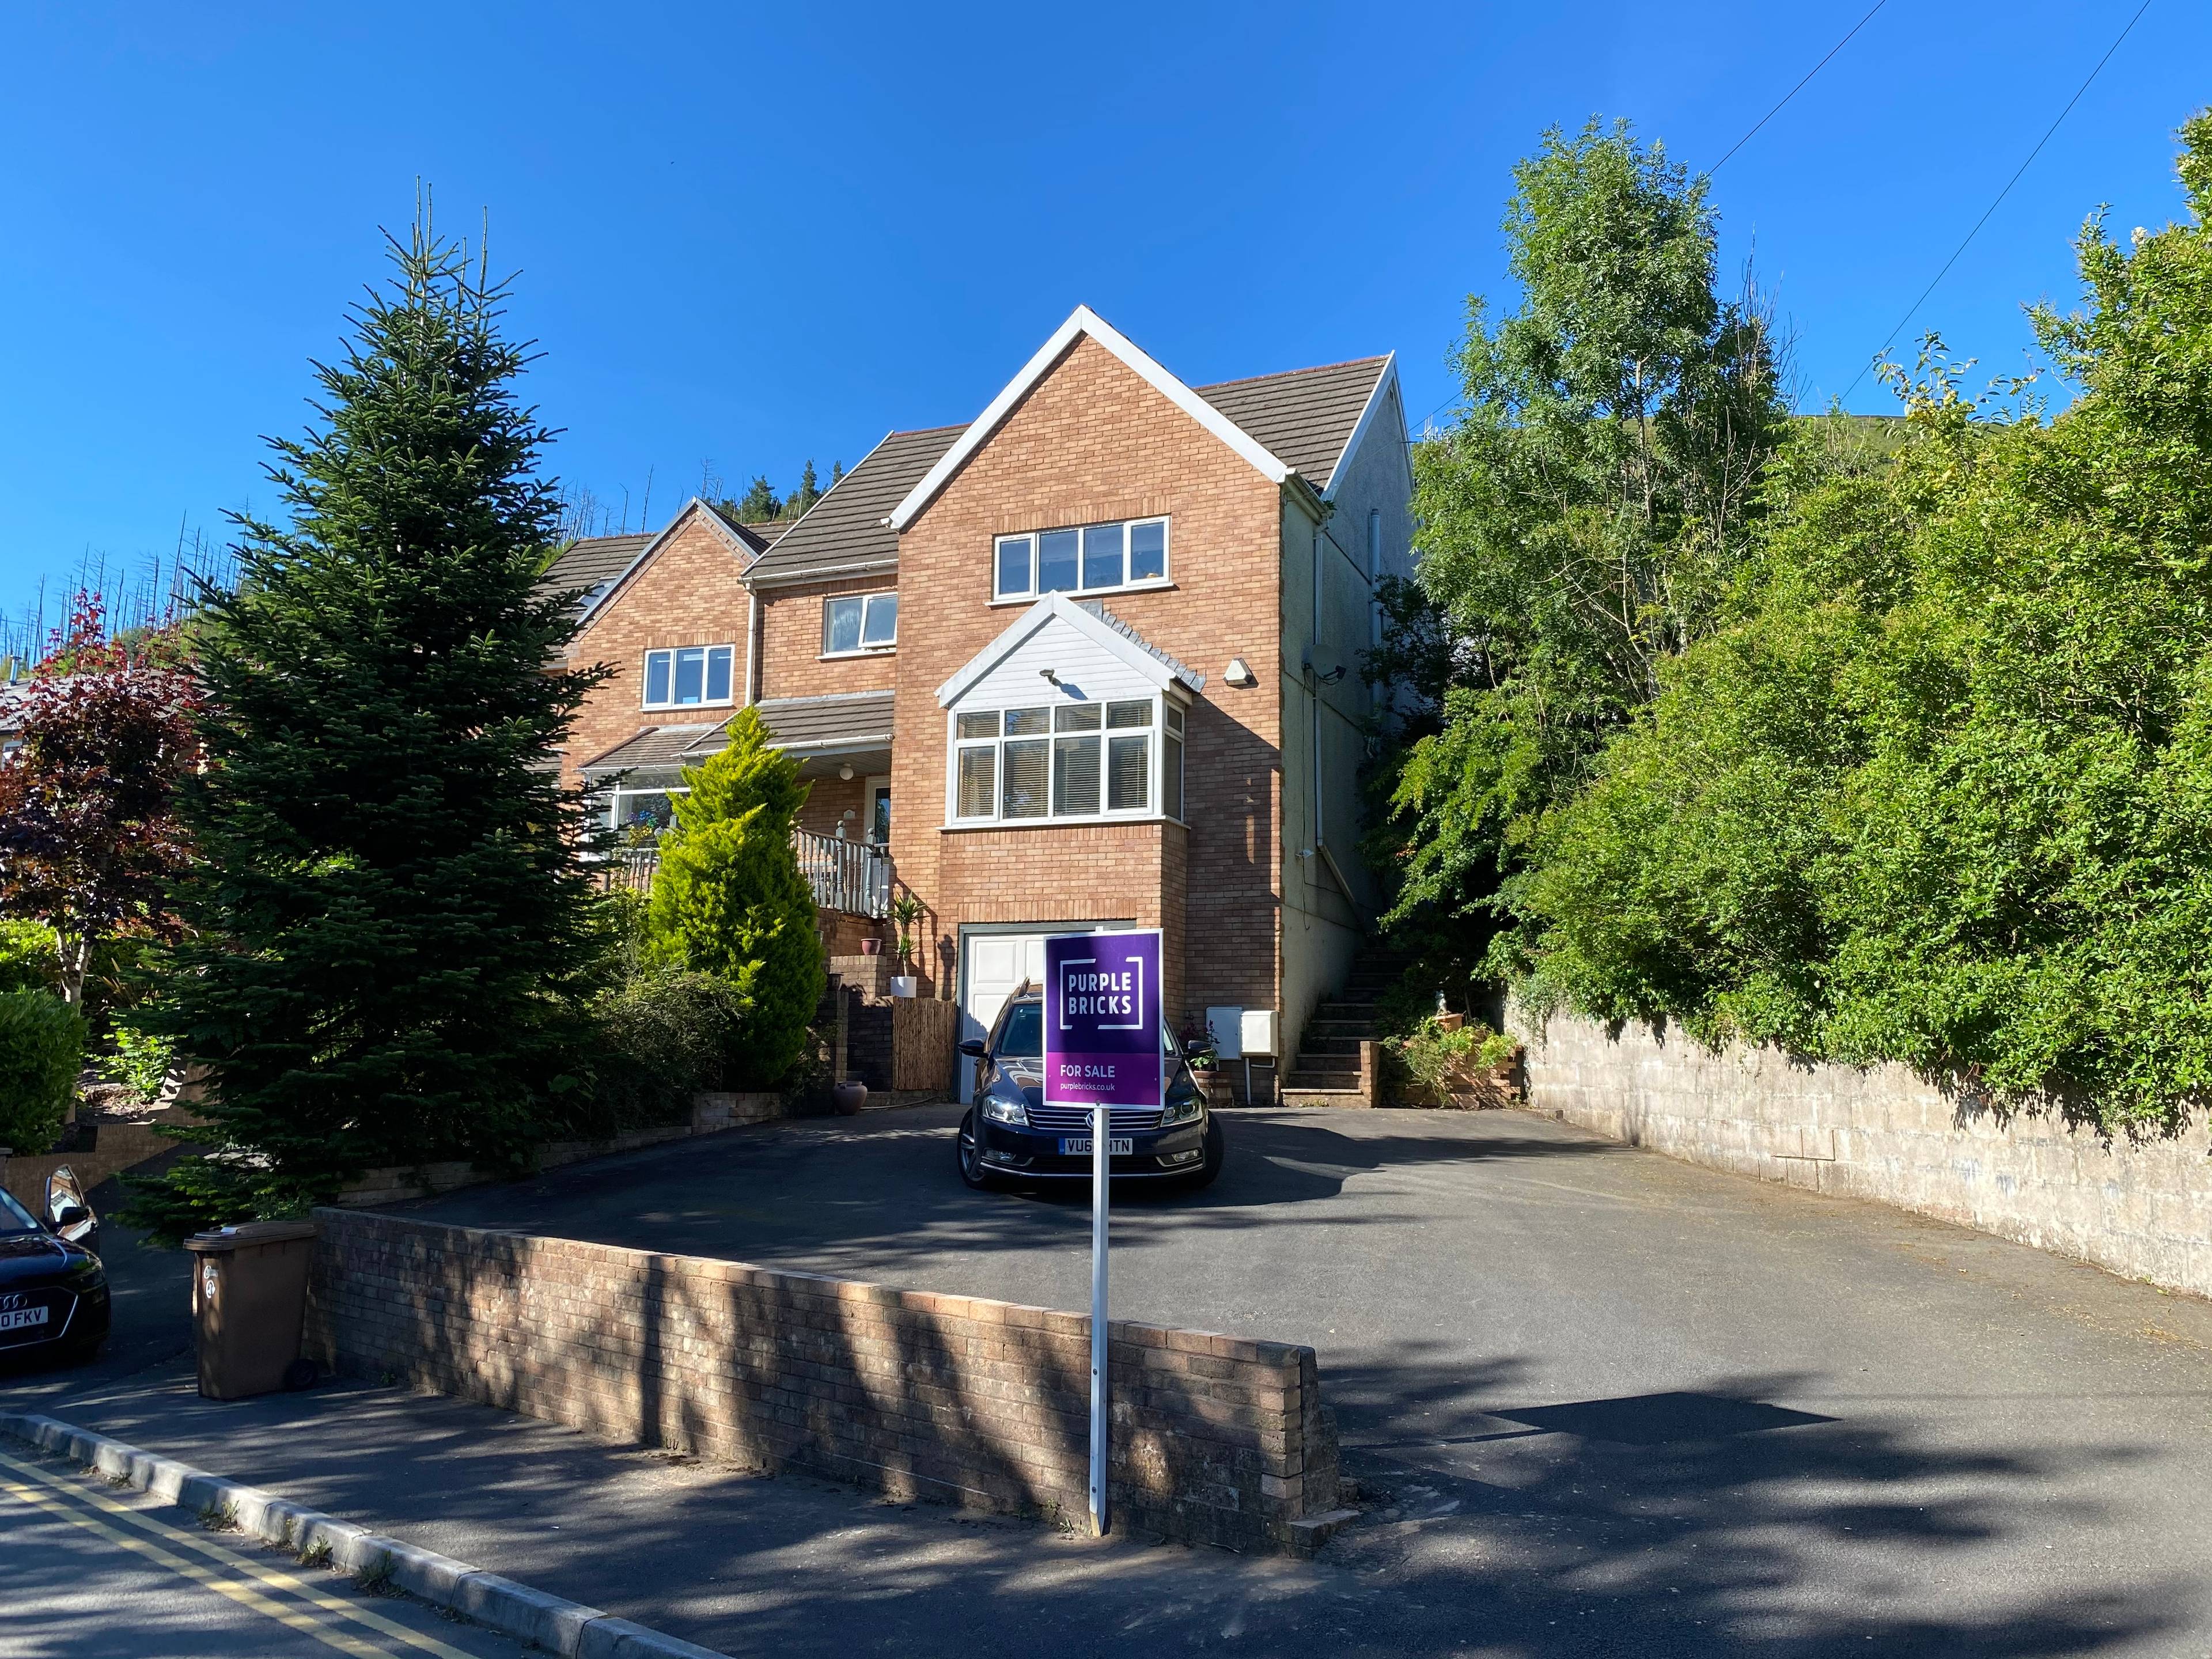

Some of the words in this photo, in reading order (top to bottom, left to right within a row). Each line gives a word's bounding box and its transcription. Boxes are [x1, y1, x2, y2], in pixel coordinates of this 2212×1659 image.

[1069, 972, 1131, 992] PURPLE
[1069, 995, 1131, 1014] BRICKS
[1060, 1064, 1081, 1077] FOR
[1085, 1065, 1115, 1078] SALE
[1060, 1082, 1115, 1091] purplebricks.co.uk
[1067, 1139, 1093, 1152] VU6
[14, 1309, 41, 1325] FKV
